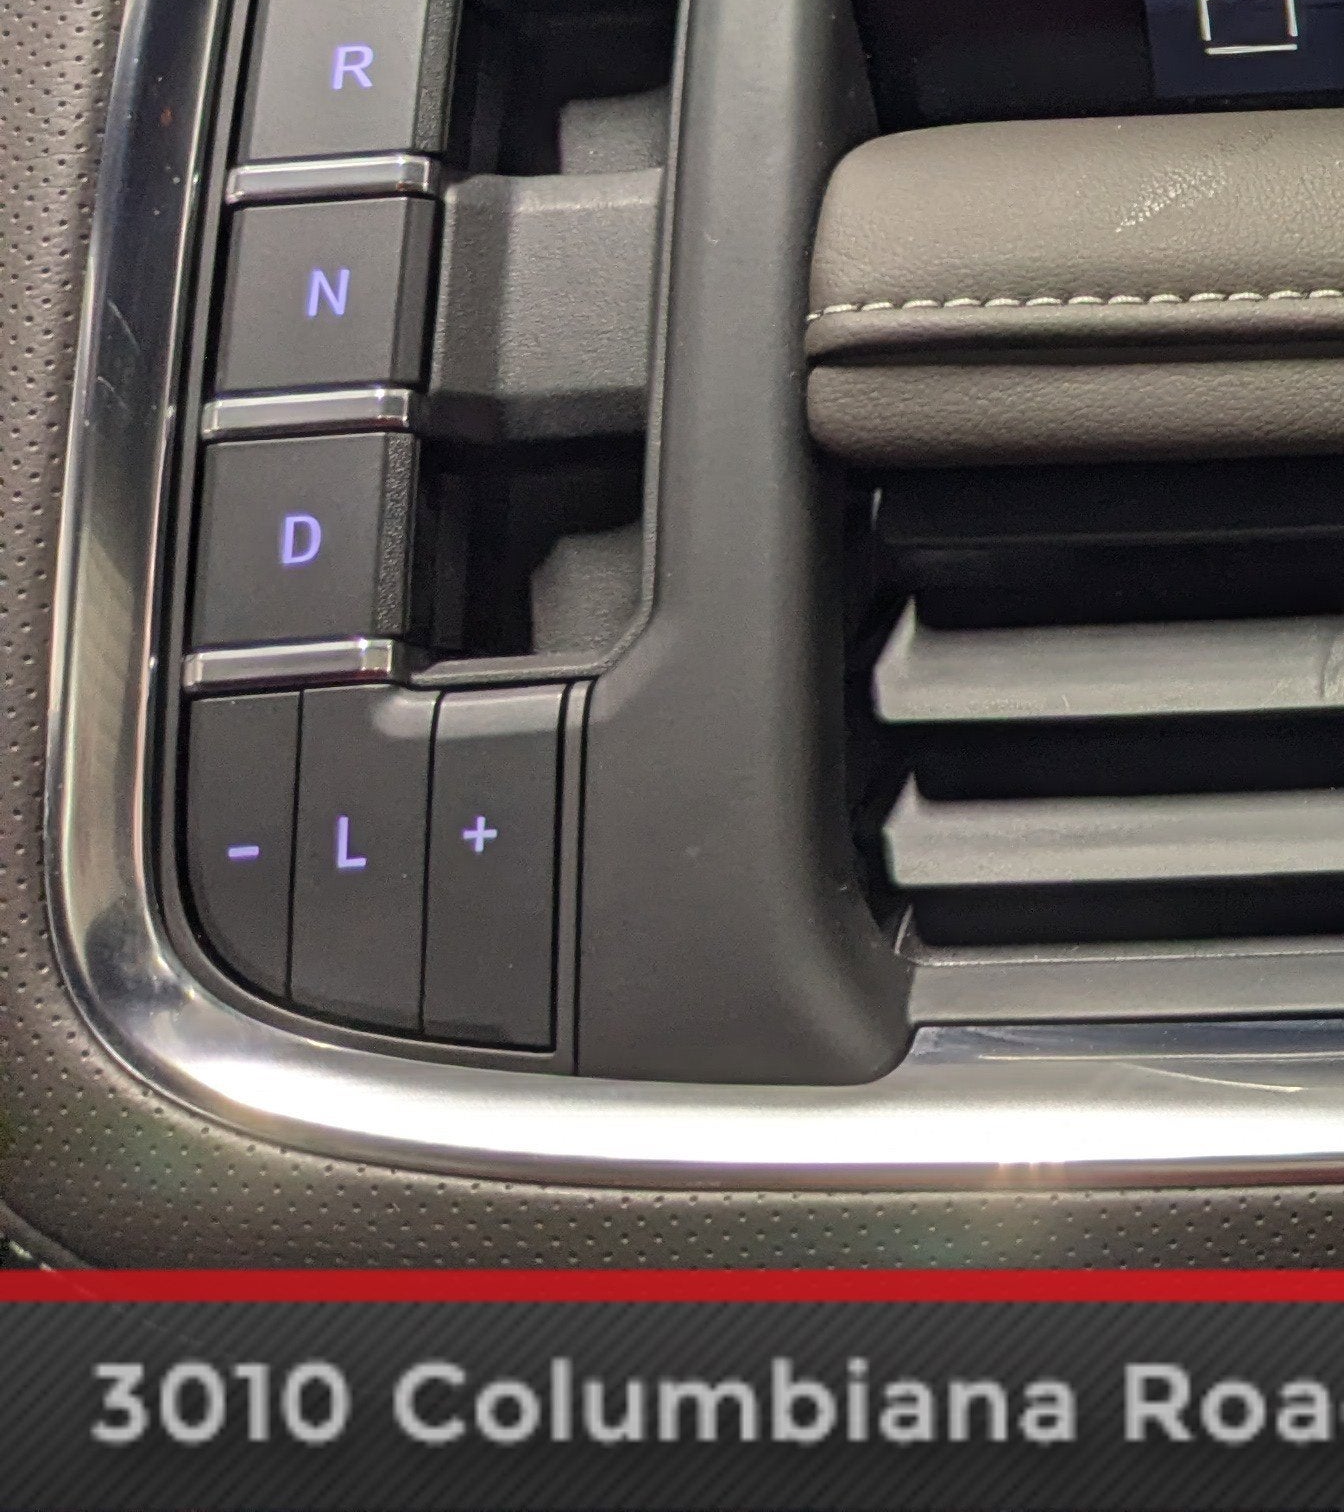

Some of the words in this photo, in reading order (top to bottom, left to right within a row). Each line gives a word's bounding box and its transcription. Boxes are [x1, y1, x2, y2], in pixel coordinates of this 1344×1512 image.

[332, 44, 375, 90] R
[307, 268, 350, 318] N
[281, 514, 323, 567] D
[337, 815, 367, 869] L
